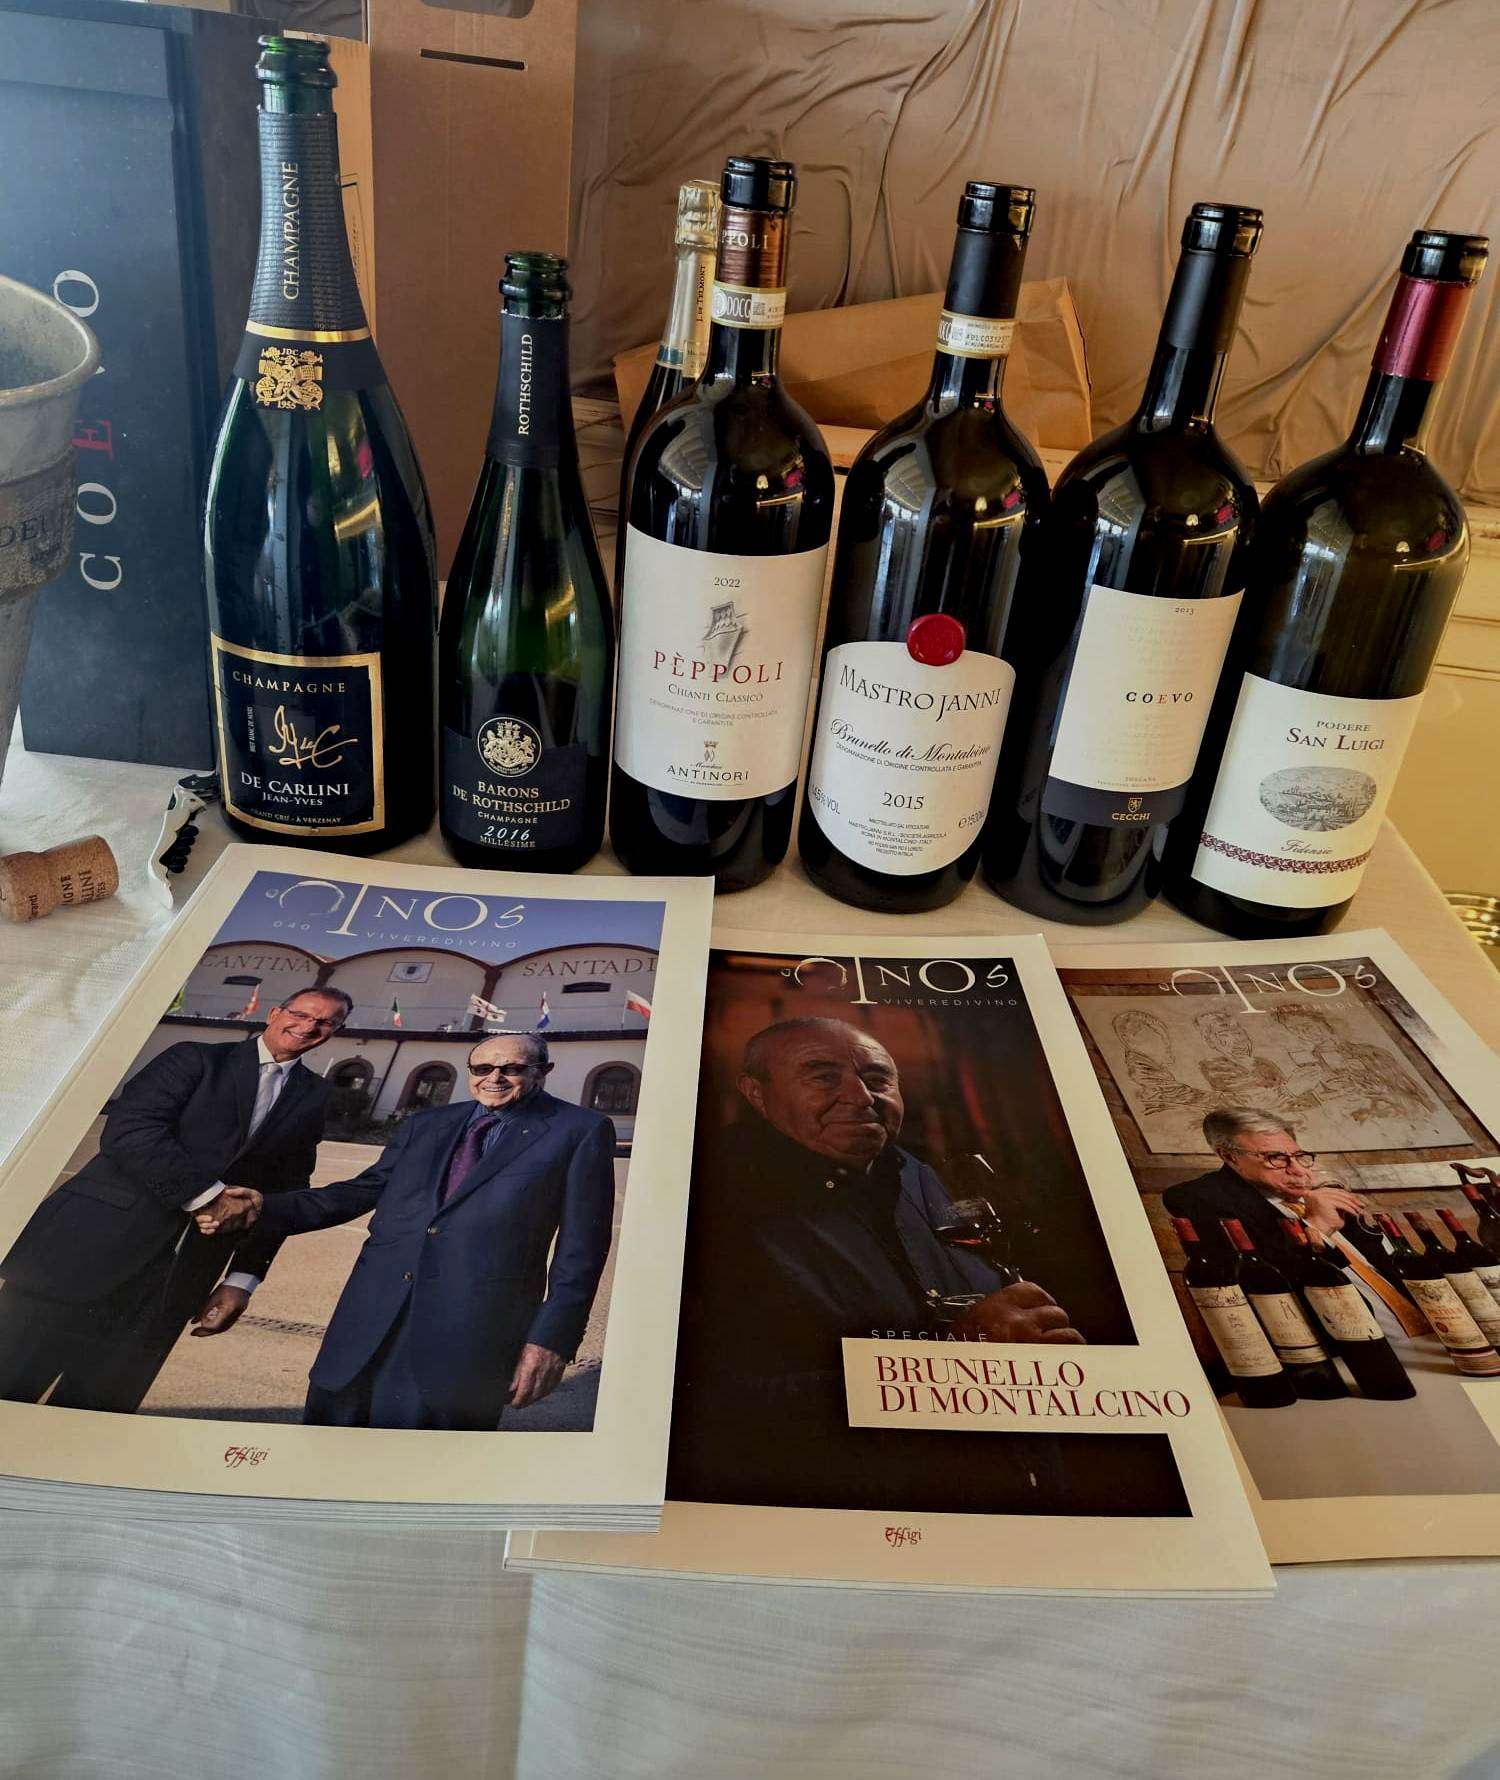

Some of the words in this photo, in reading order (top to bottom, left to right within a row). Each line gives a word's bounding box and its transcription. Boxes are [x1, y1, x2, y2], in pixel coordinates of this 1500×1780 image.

[282, 162, 300, 300] CHAMPAGNE
[518, 334, 533, 436] ROTHSCHILD
[53, 269, 123, 591] COEO
[713, 576, 741, 588] 2022
[1174, 606, 1195, 616] 2013
[653, 649, 785, 685] PÈPPOLI
[232, 670, 346, 694] CHAMPAGNE
[1125, 691, 1194, 705] COEVO
[1316, 720, 1371, 732] PODERE
[830, 718, 892, 755] Brunello
[895, 745, 913, 759] di
[911, 743, 992, 762] Montalcino
[666, 764, 749, 781] ANTINORI
[240, 771, 262, 789] DE
[268, 779, 350, 797] CARLINI
[478, 780, 540, 799] BARONS
[452, 785, 468, 801] DE
[472, 794, 571, 814] ROTHSCHILD
[881, 792, 925, 810] 2015
[477, 811, 539, 824] CHAMPAGNE
[1111, 812, 1152, 821] CECCHI
[484, 825, 531, 841] 2016
[272, 919, 311, 931] 040
[365, 930, 519, 949] VIVEREDIVINO
[522, 956, 657, 977] SANTADI
[883, 998, 1018, 1006] VIVEREDIVINO
[874, 1355, 1086, 1388] BRUNELLO
[879, 1384, 921, 1413] DI
[927, 1386, 1192, 1418] MONTALCINO
